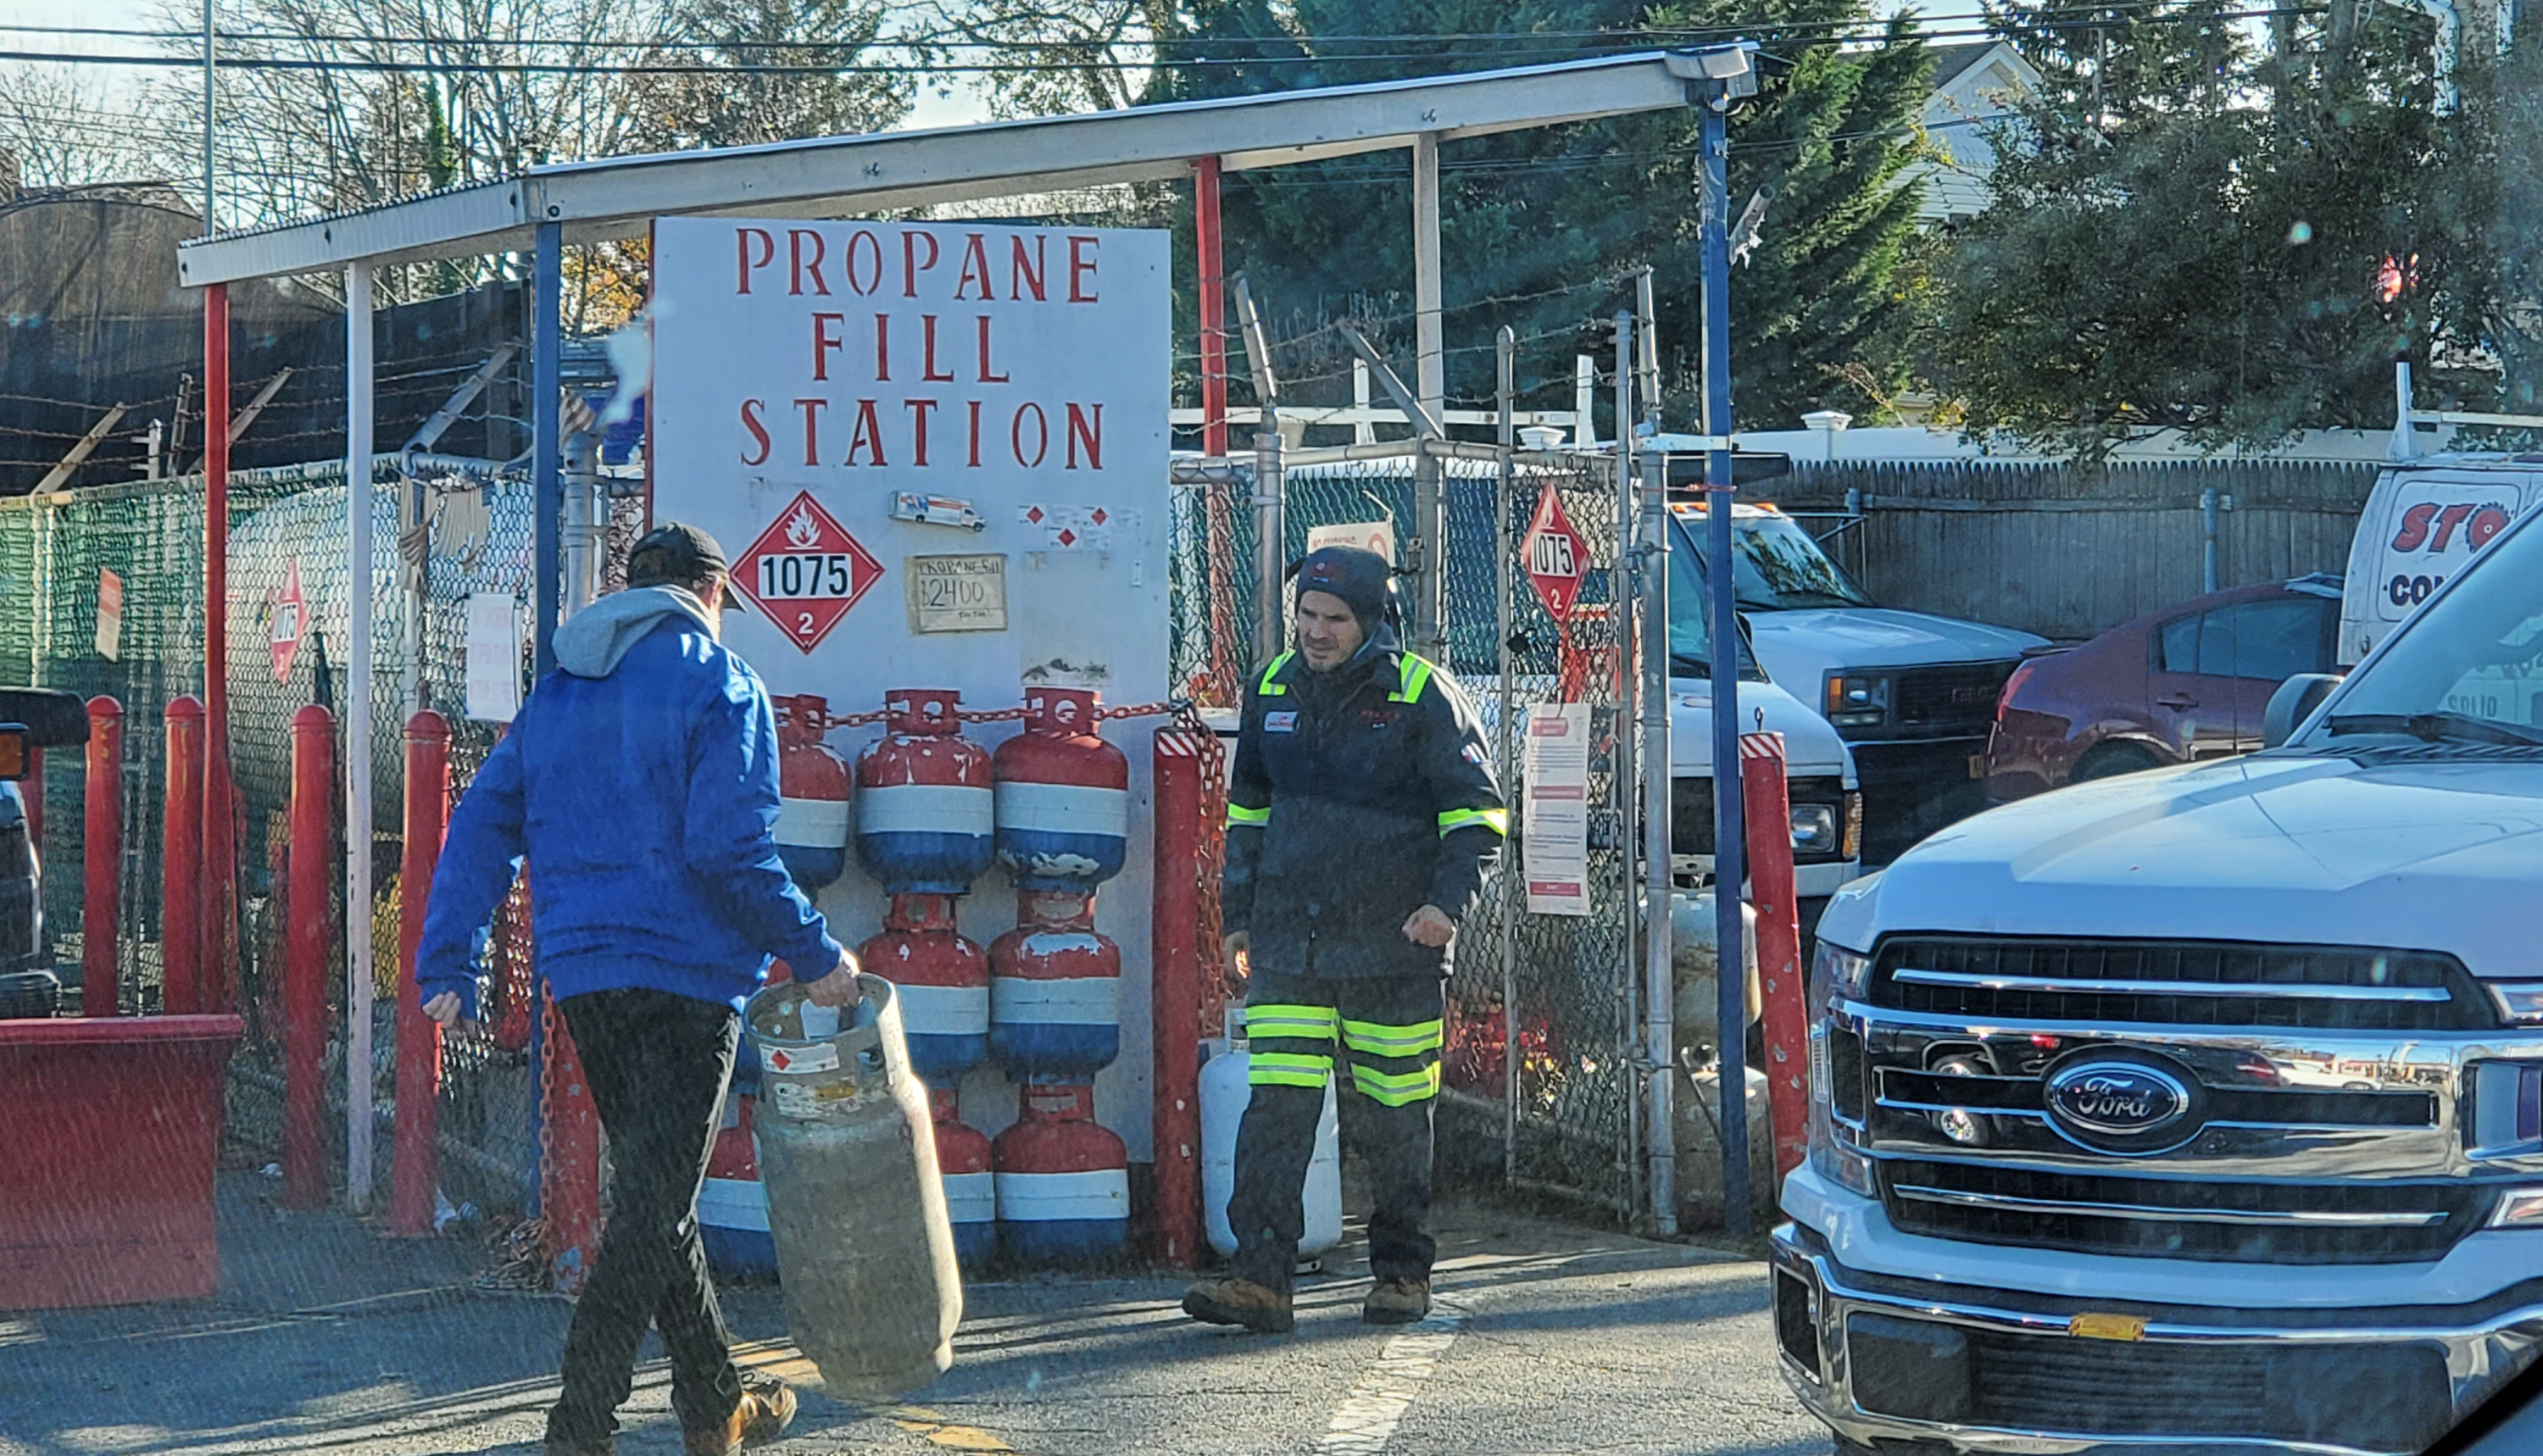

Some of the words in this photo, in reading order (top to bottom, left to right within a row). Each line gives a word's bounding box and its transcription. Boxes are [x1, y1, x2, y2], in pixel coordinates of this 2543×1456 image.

[736, 228, 1099, 303] PROPANE
[811, 312, 1010, 383] FILL
[740, 399, 1104, 470] STATION
[762, 555, 848, 596] 1075
[1533, 535, 1573, 575] 1075
[1550, 588, 1562, 609] 2
[798, 612, 815, 634] 2
[2078, 1076, 2153, 1118] Ford
